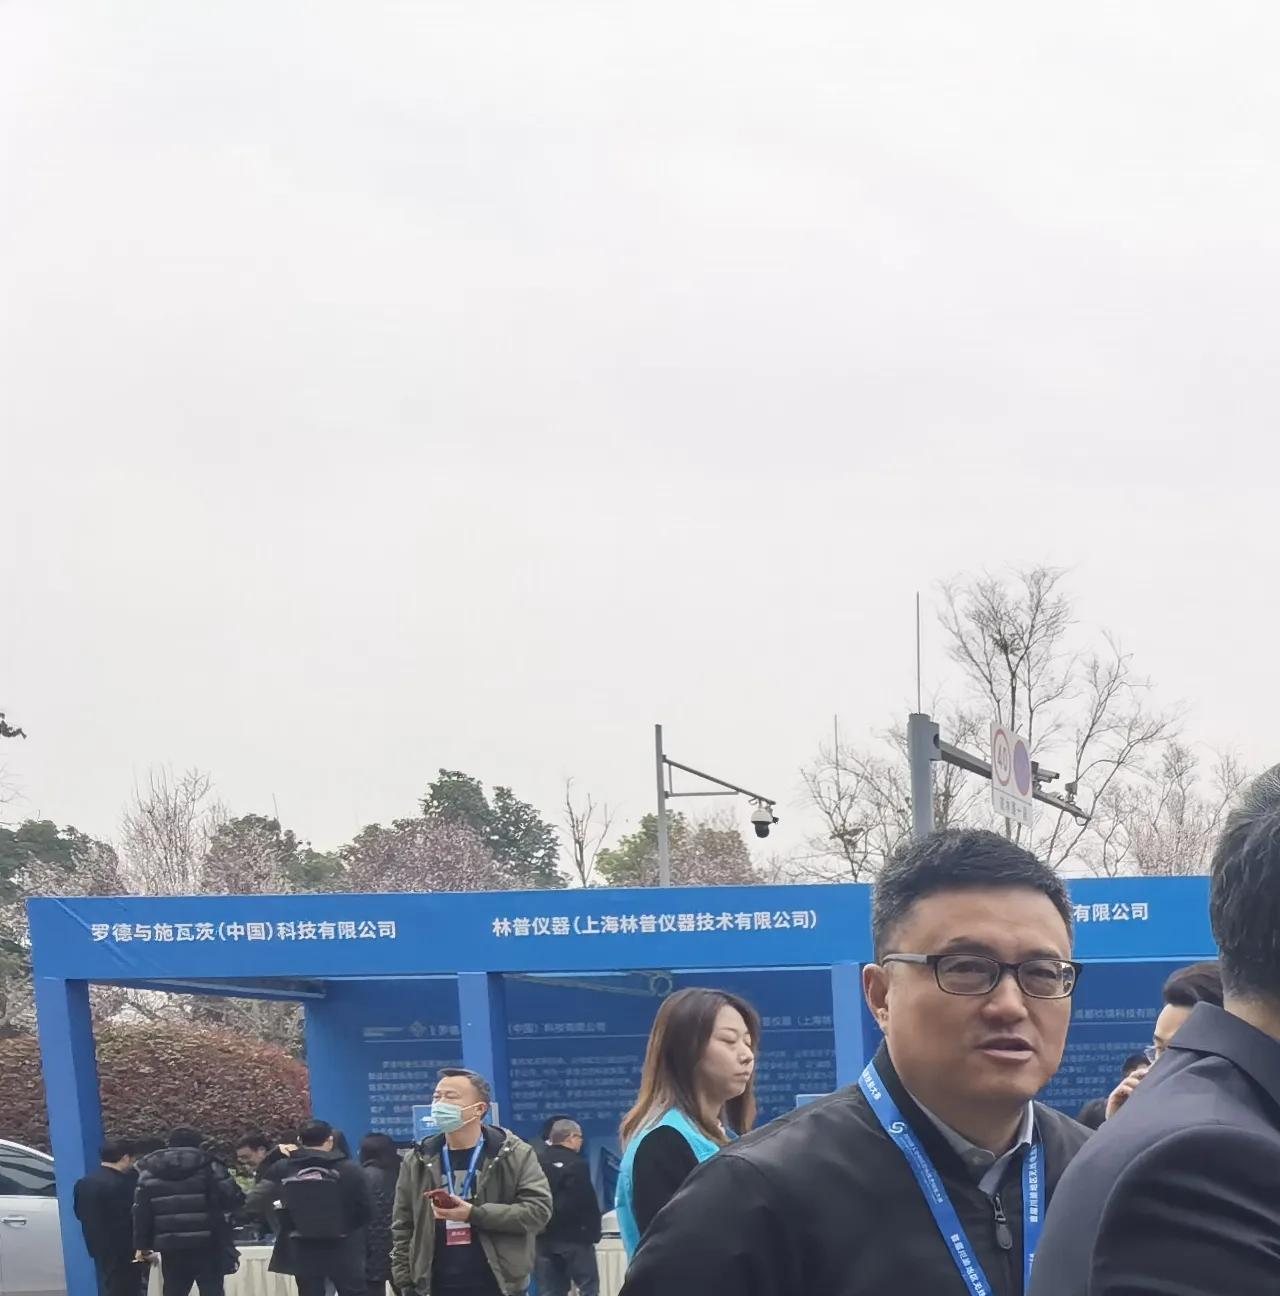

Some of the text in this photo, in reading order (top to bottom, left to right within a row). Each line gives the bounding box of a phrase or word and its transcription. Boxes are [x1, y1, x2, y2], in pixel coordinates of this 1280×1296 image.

[491, 909, 817, 938] 林普仪器（上海林普仪器技术有限公司）
[1073, 902, 1149, 923] 有限公司
[90, 919, 398, 943] 罗德与施瓦茨（中国）科技有限公司
